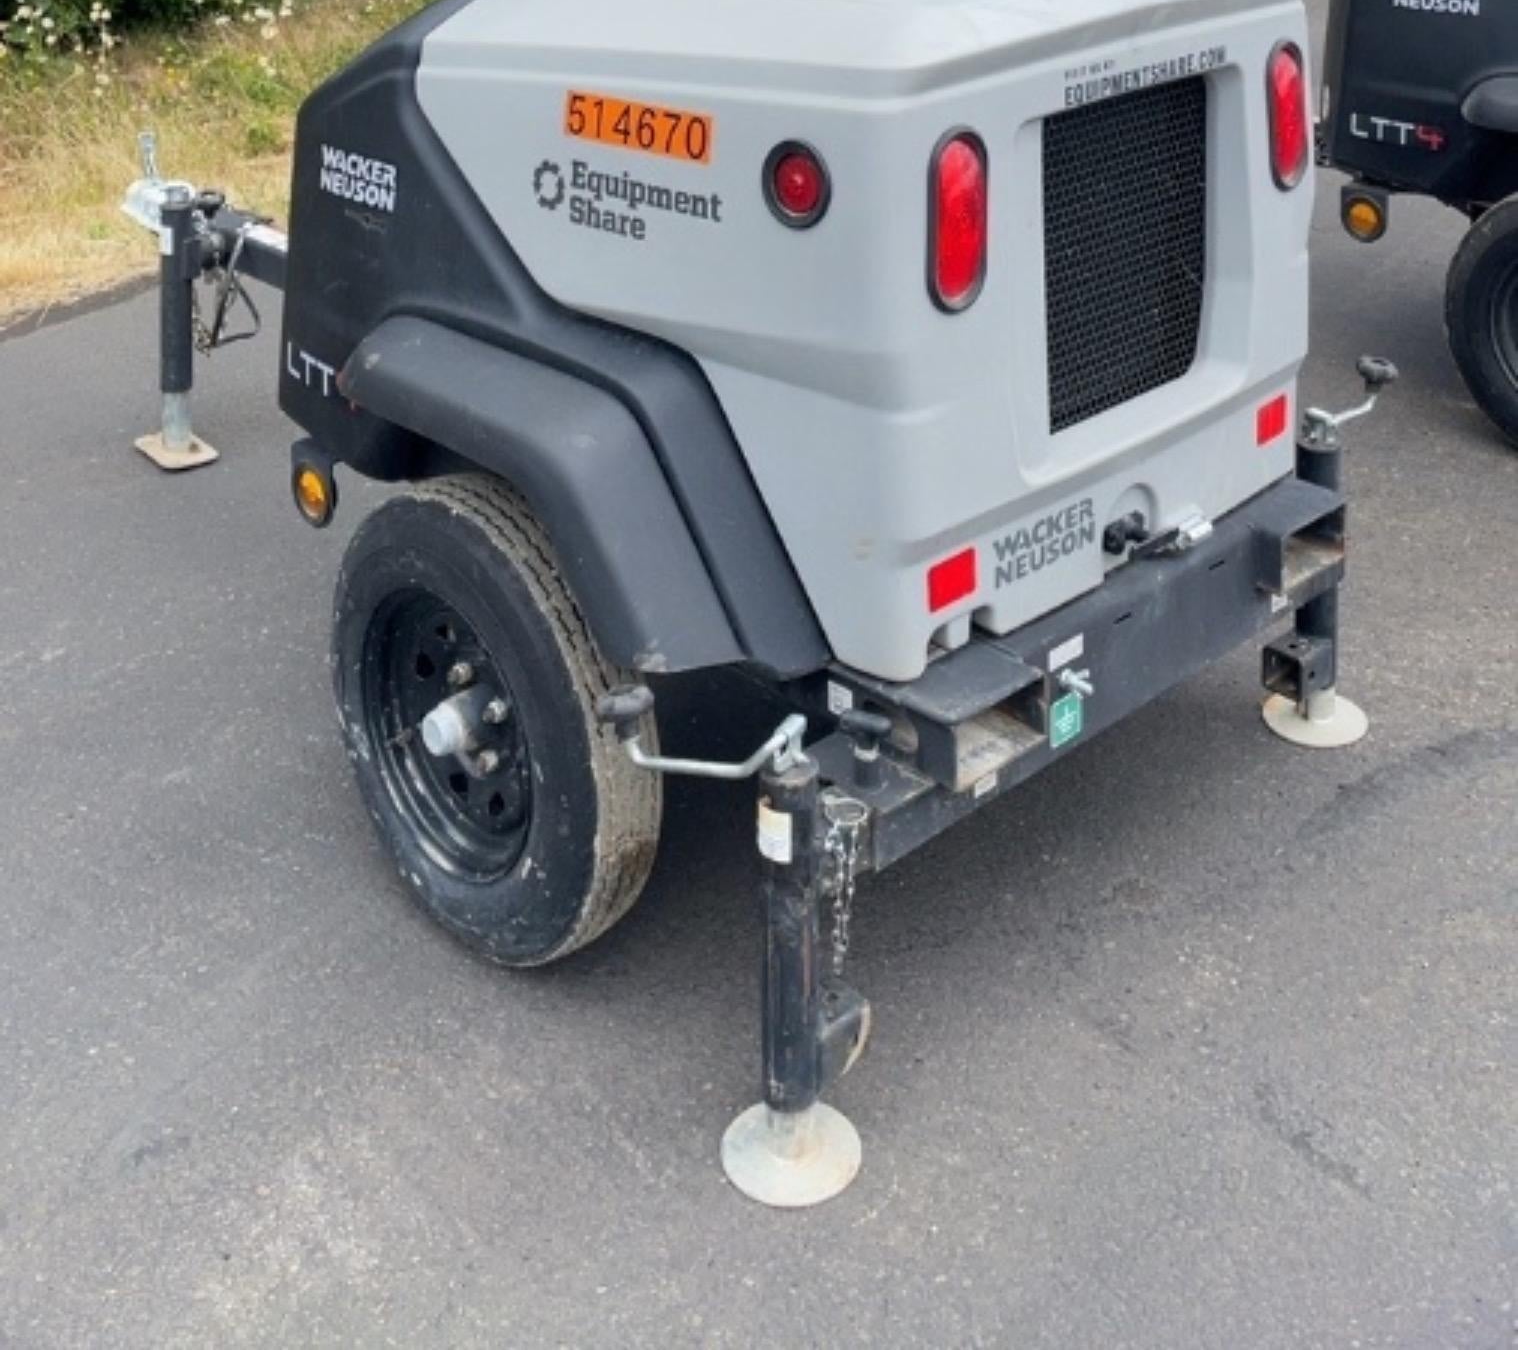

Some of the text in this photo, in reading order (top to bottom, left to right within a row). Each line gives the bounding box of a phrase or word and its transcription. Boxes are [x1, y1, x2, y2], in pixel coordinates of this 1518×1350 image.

[1064, 44, 1227, 108] EQUIPMENTSHARE.COM
[567, 94, 708, 161] 514670
[1351, 112, 1444, 150] LTT4
[321, 143, 397, 190] WACKER
[321, 167, 397, 213] NEUSON
[570, 159, 723, 223] Equipment
[569, 194, 647, 240] Share
[286, 340, 343, 400] LTT
[992, 497, 1095, 562] WACKER
[995, 520, 1096, 590] NEUSON
